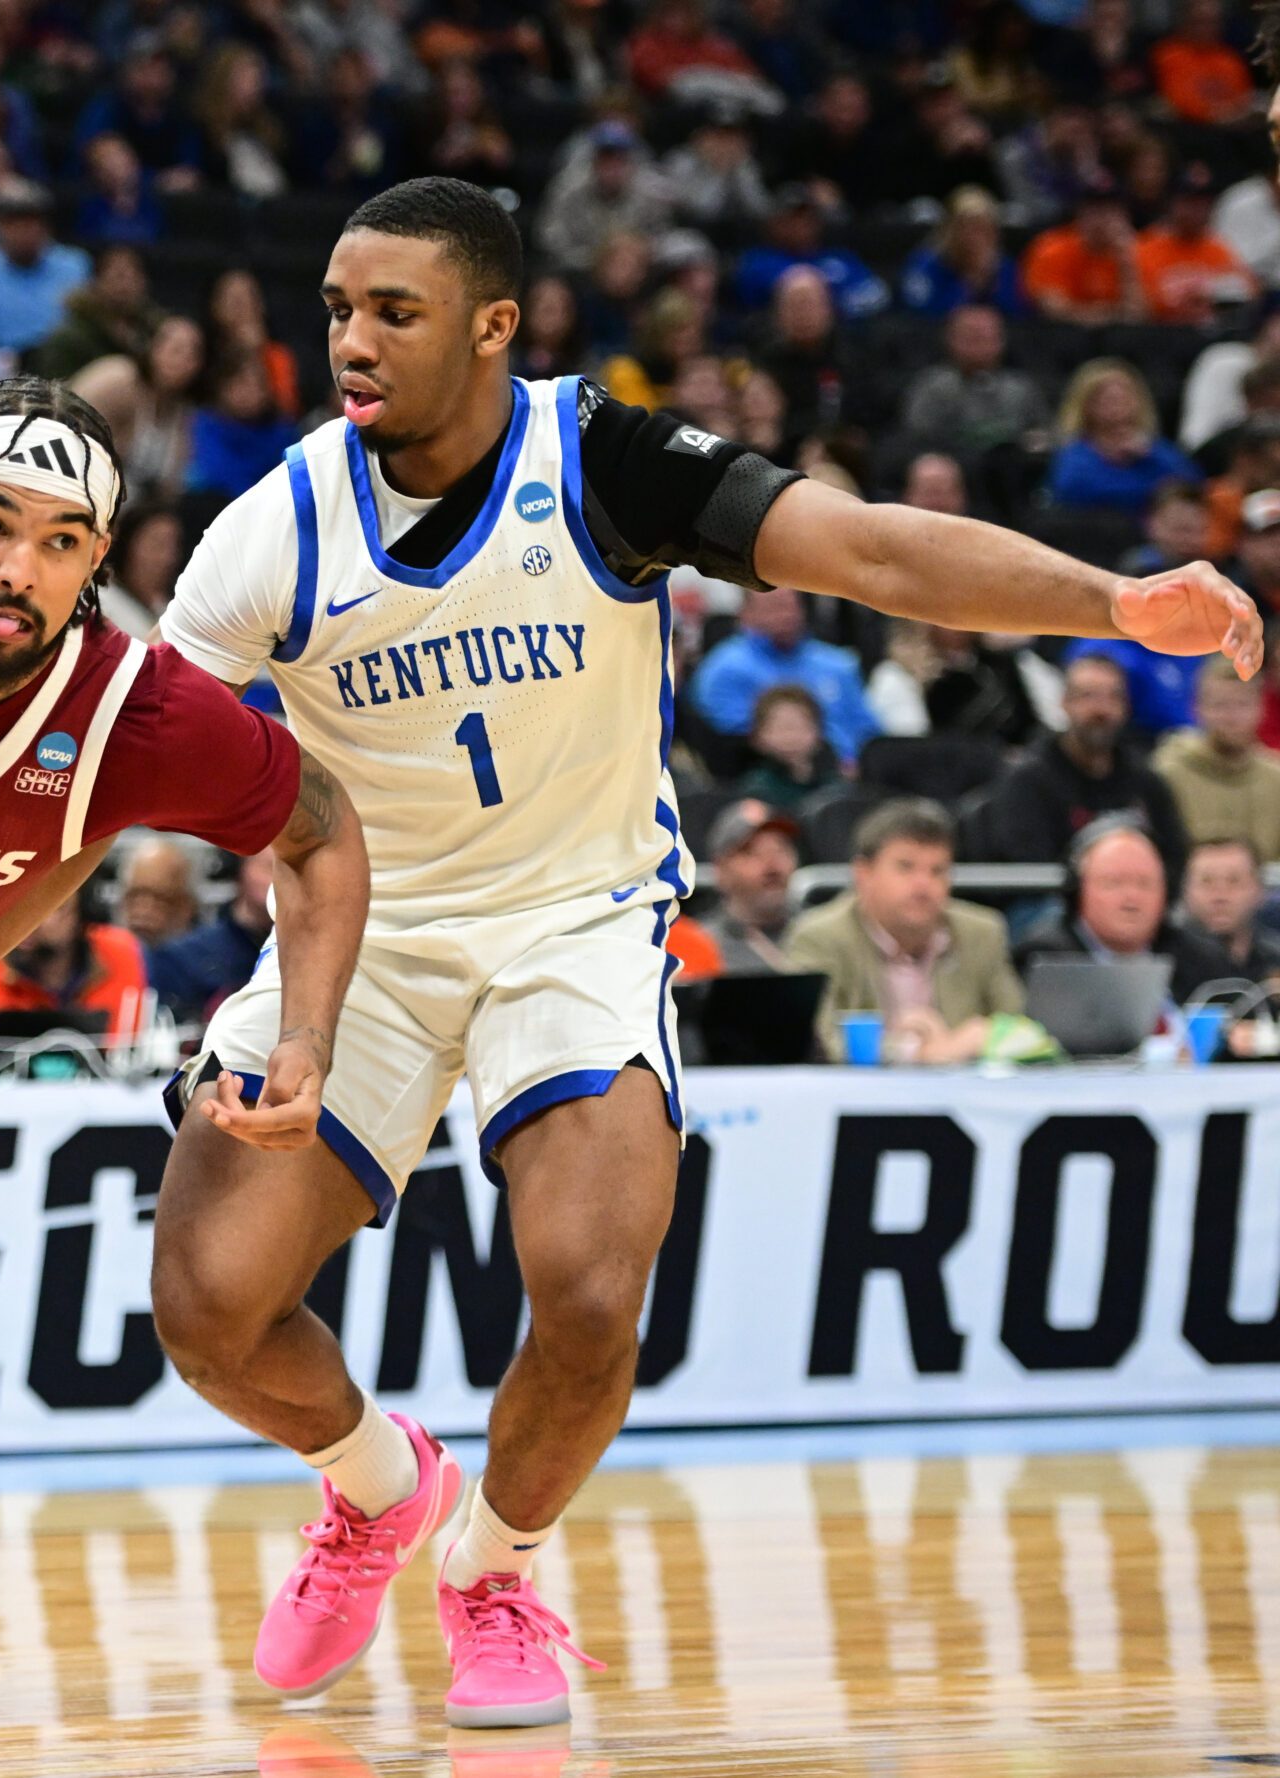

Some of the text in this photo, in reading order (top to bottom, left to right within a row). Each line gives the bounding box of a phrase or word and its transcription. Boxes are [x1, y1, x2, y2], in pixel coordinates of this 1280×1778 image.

[521, 497, 554, 514] NCAA
[523, 546, 551, 575] SEC
[329, 624, 585, 708] KENTUCKY
[40, 748, 72, 763] NCAA
[455, 713, 503, 808] 1
[15, 767, 70, 797] SBC
